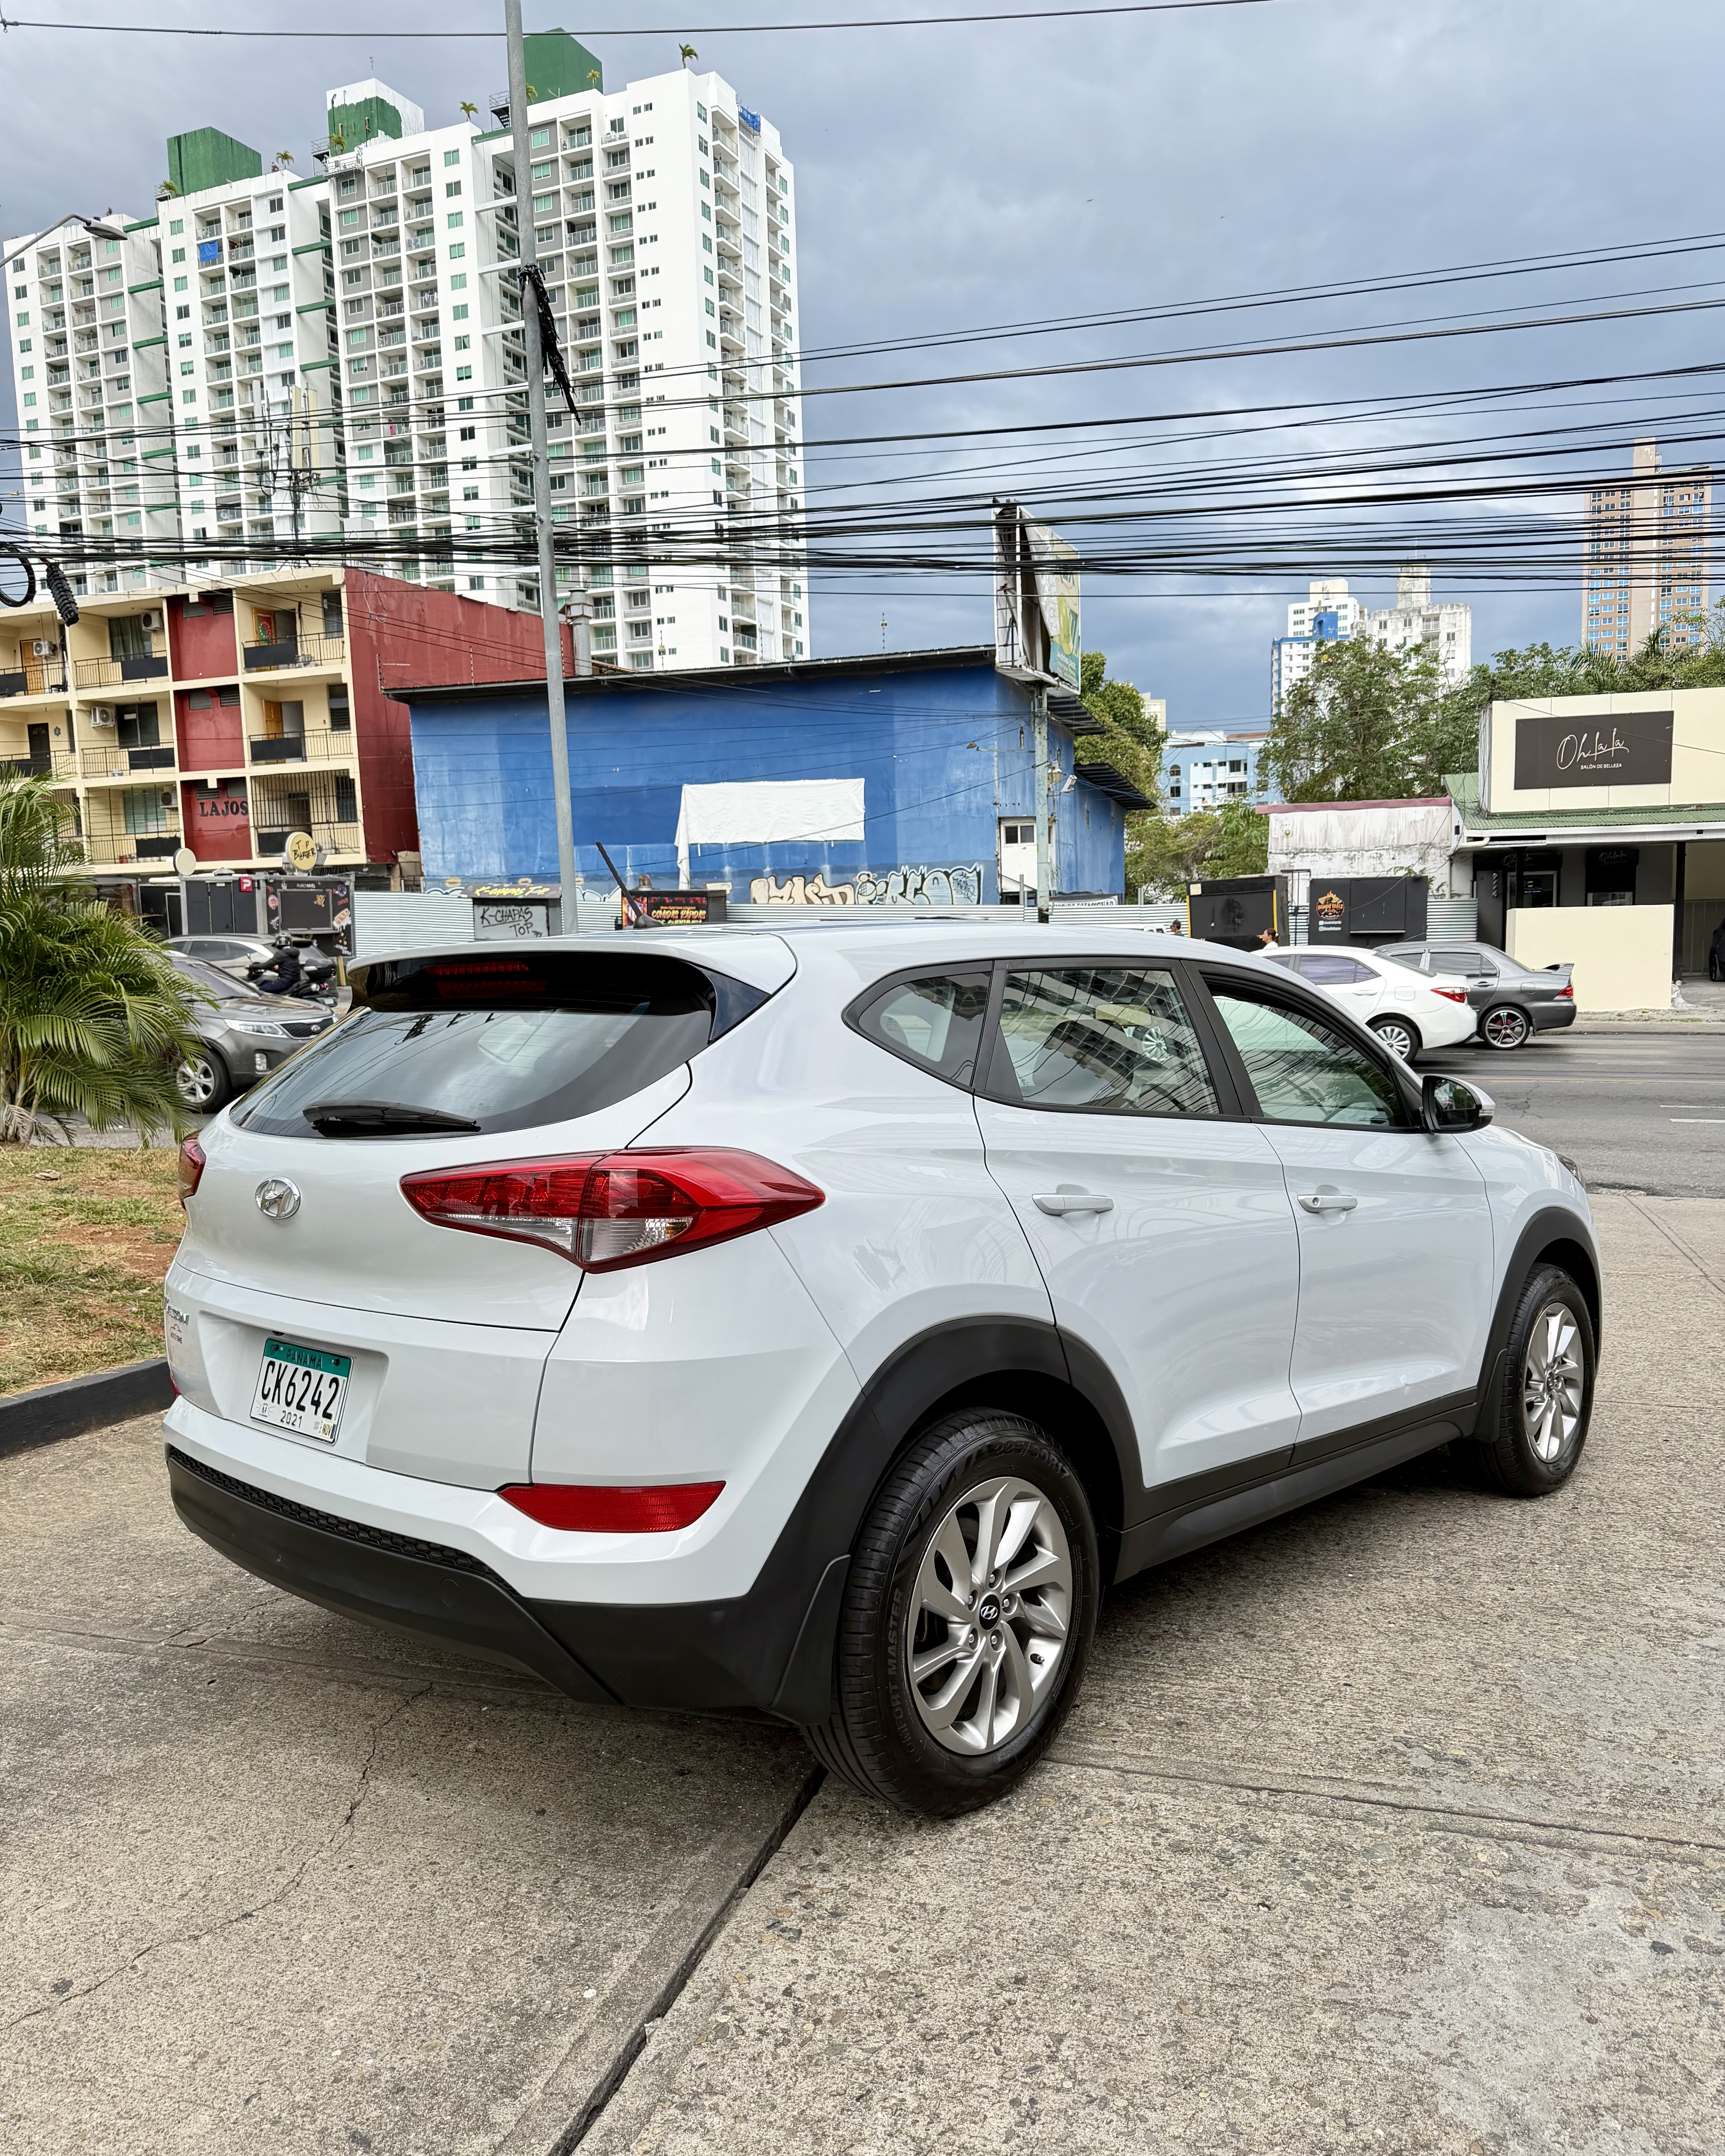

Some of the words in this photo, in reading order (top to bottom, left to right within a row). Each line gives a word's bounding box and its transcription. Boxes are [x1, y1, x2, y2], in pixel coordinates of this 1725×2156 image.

[480, 907, 533, 925] K-CHAPAS
[652, 910, 679, 919] COMIDAS
[509, 922, 533, 937] TOP
[286, 1348, 322, 1369] PANAMA
[261, 1360, 339, 1419] CK6242
[280, 1410, 302, 1429] 2021
[322, 1423, 332, 1436] NOV
[888, 1588, 903, 1675] MASTER
[889, 1682, 922, 1763] COMFORT
